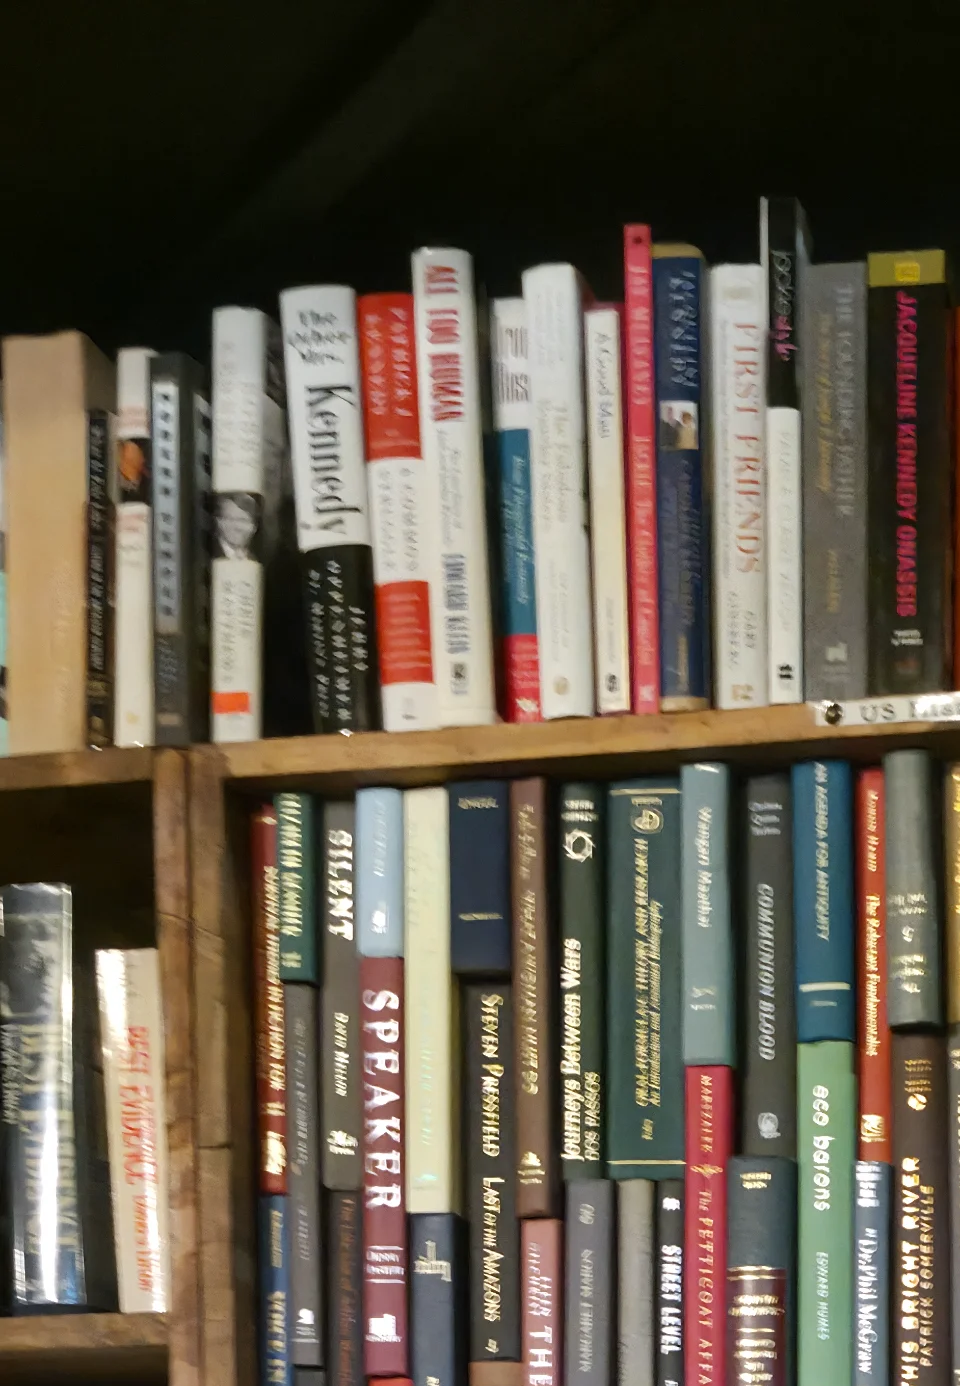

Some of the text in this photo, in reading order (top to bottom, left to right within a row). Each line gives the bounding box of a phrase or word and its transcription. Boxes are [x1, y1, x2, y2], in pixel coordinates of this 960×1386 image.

[425, 265, 465, 422] ALL TOO HUMAN
[307, 383, 362, 536] Kennedy
[896, 291, 917, 617] JACQUELINE KENNEDY ONASSIS
[860, 702, 895, 722] US
[328, 829, 354, 940] SILENT
[481, 993, 503, 1058] STEVEN
[560, 938, 585, 1161] Journeys Between Wars
[363, 989, 400, 1210] SPEAKER
[481, 1063, 504, 1157] PRESSFIELD
[812, 1085, 836, 1212] eco barons
[483, 1177, 505, 1211] LAST
[900, 1157, 920, 1230] RIVER
[483, 1248, 504, 1322] AMAZONS
[659, 1244, 682, 1355] STREET LEVEL
[900, 1241, 920, 1330] BRIGHT
[528, 1326, 553, 1386] THE
